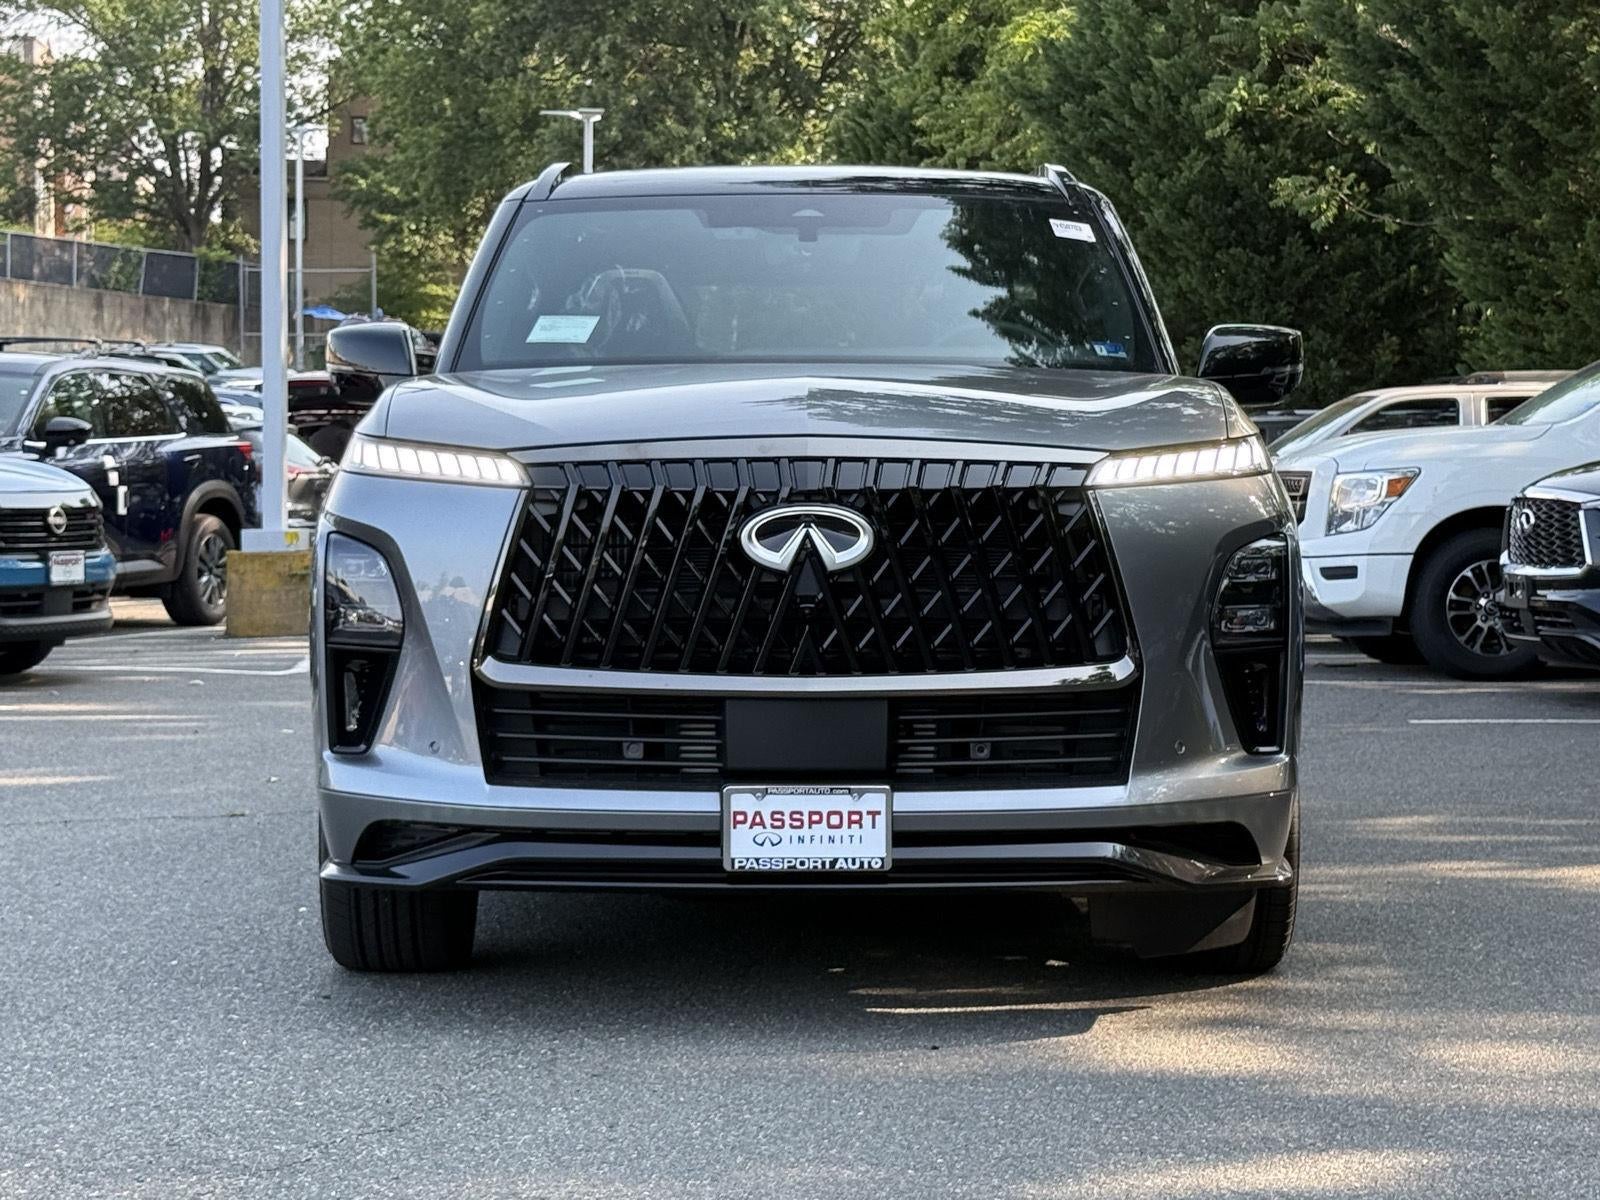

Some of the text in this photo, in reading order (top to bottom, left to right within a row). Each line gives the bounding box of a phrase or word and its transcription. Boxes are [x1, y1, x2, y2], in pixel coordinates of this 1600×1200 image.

[732, 810, 882, 830] PASSPORT
[789, 834, 863, 844] INFINITI
[734, 858, 883, 869] PASSPORT AUTO
